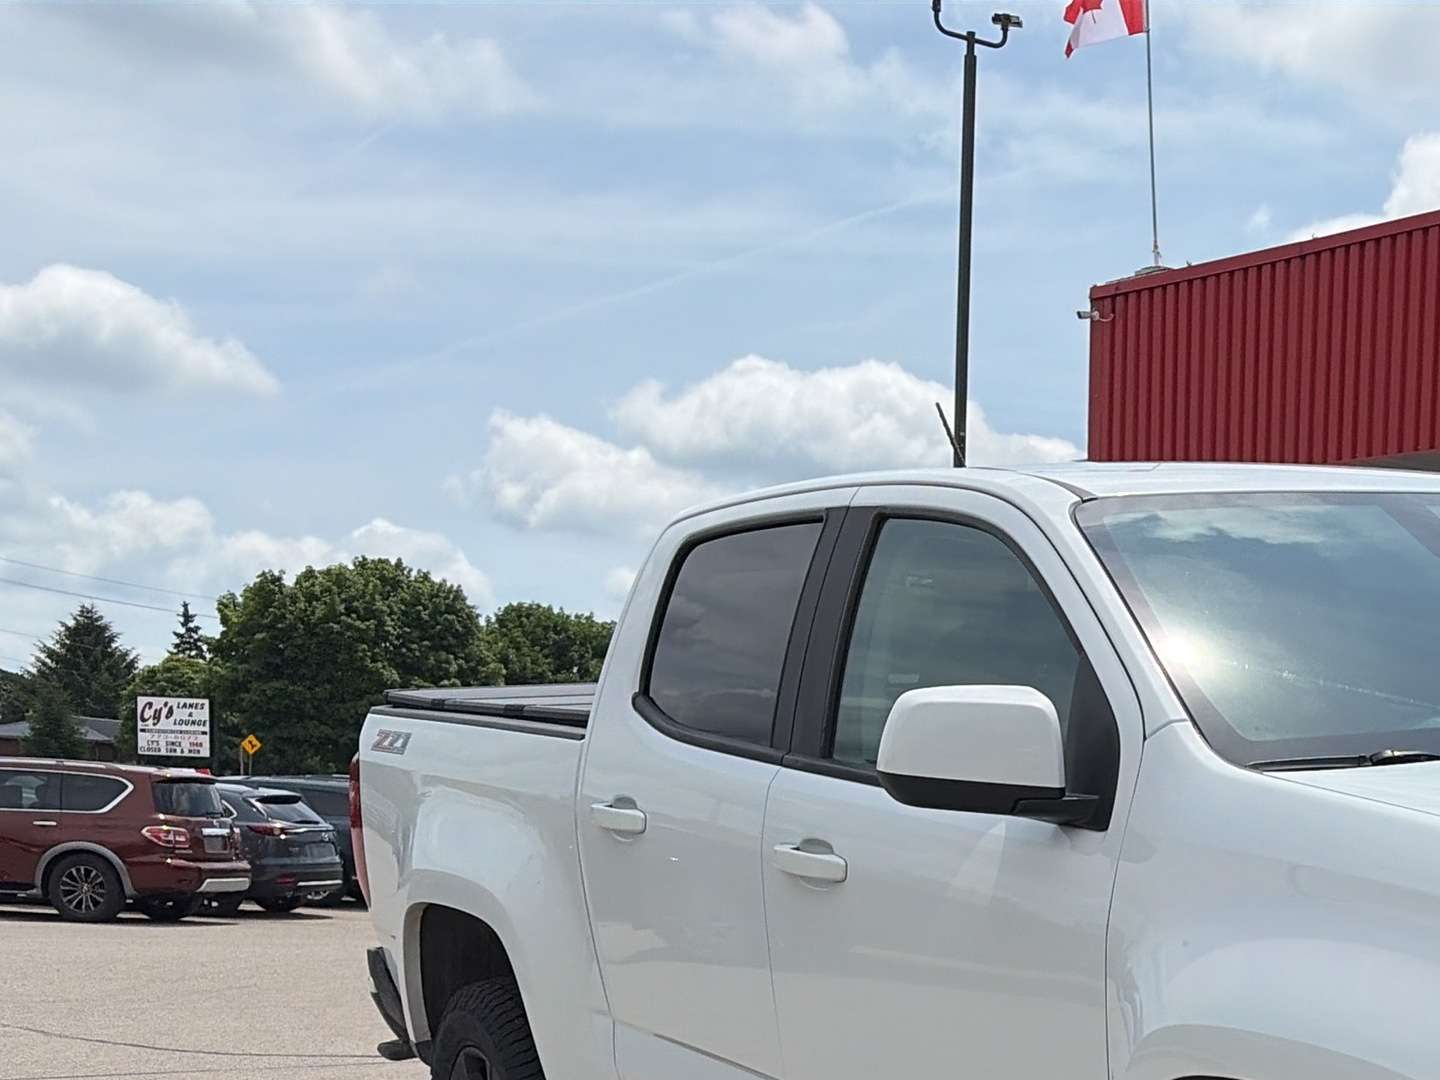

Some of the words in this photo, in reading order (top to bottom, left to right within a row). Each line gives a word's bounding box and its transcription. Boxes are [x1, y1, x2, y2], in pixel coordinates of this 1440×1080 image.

[139, 700, 174, 727] Cy's
[176, 702, 206, 711] LANES
[173, 718, 208, 728] LOUNGE
[371, 729, 412, 755] Z71
